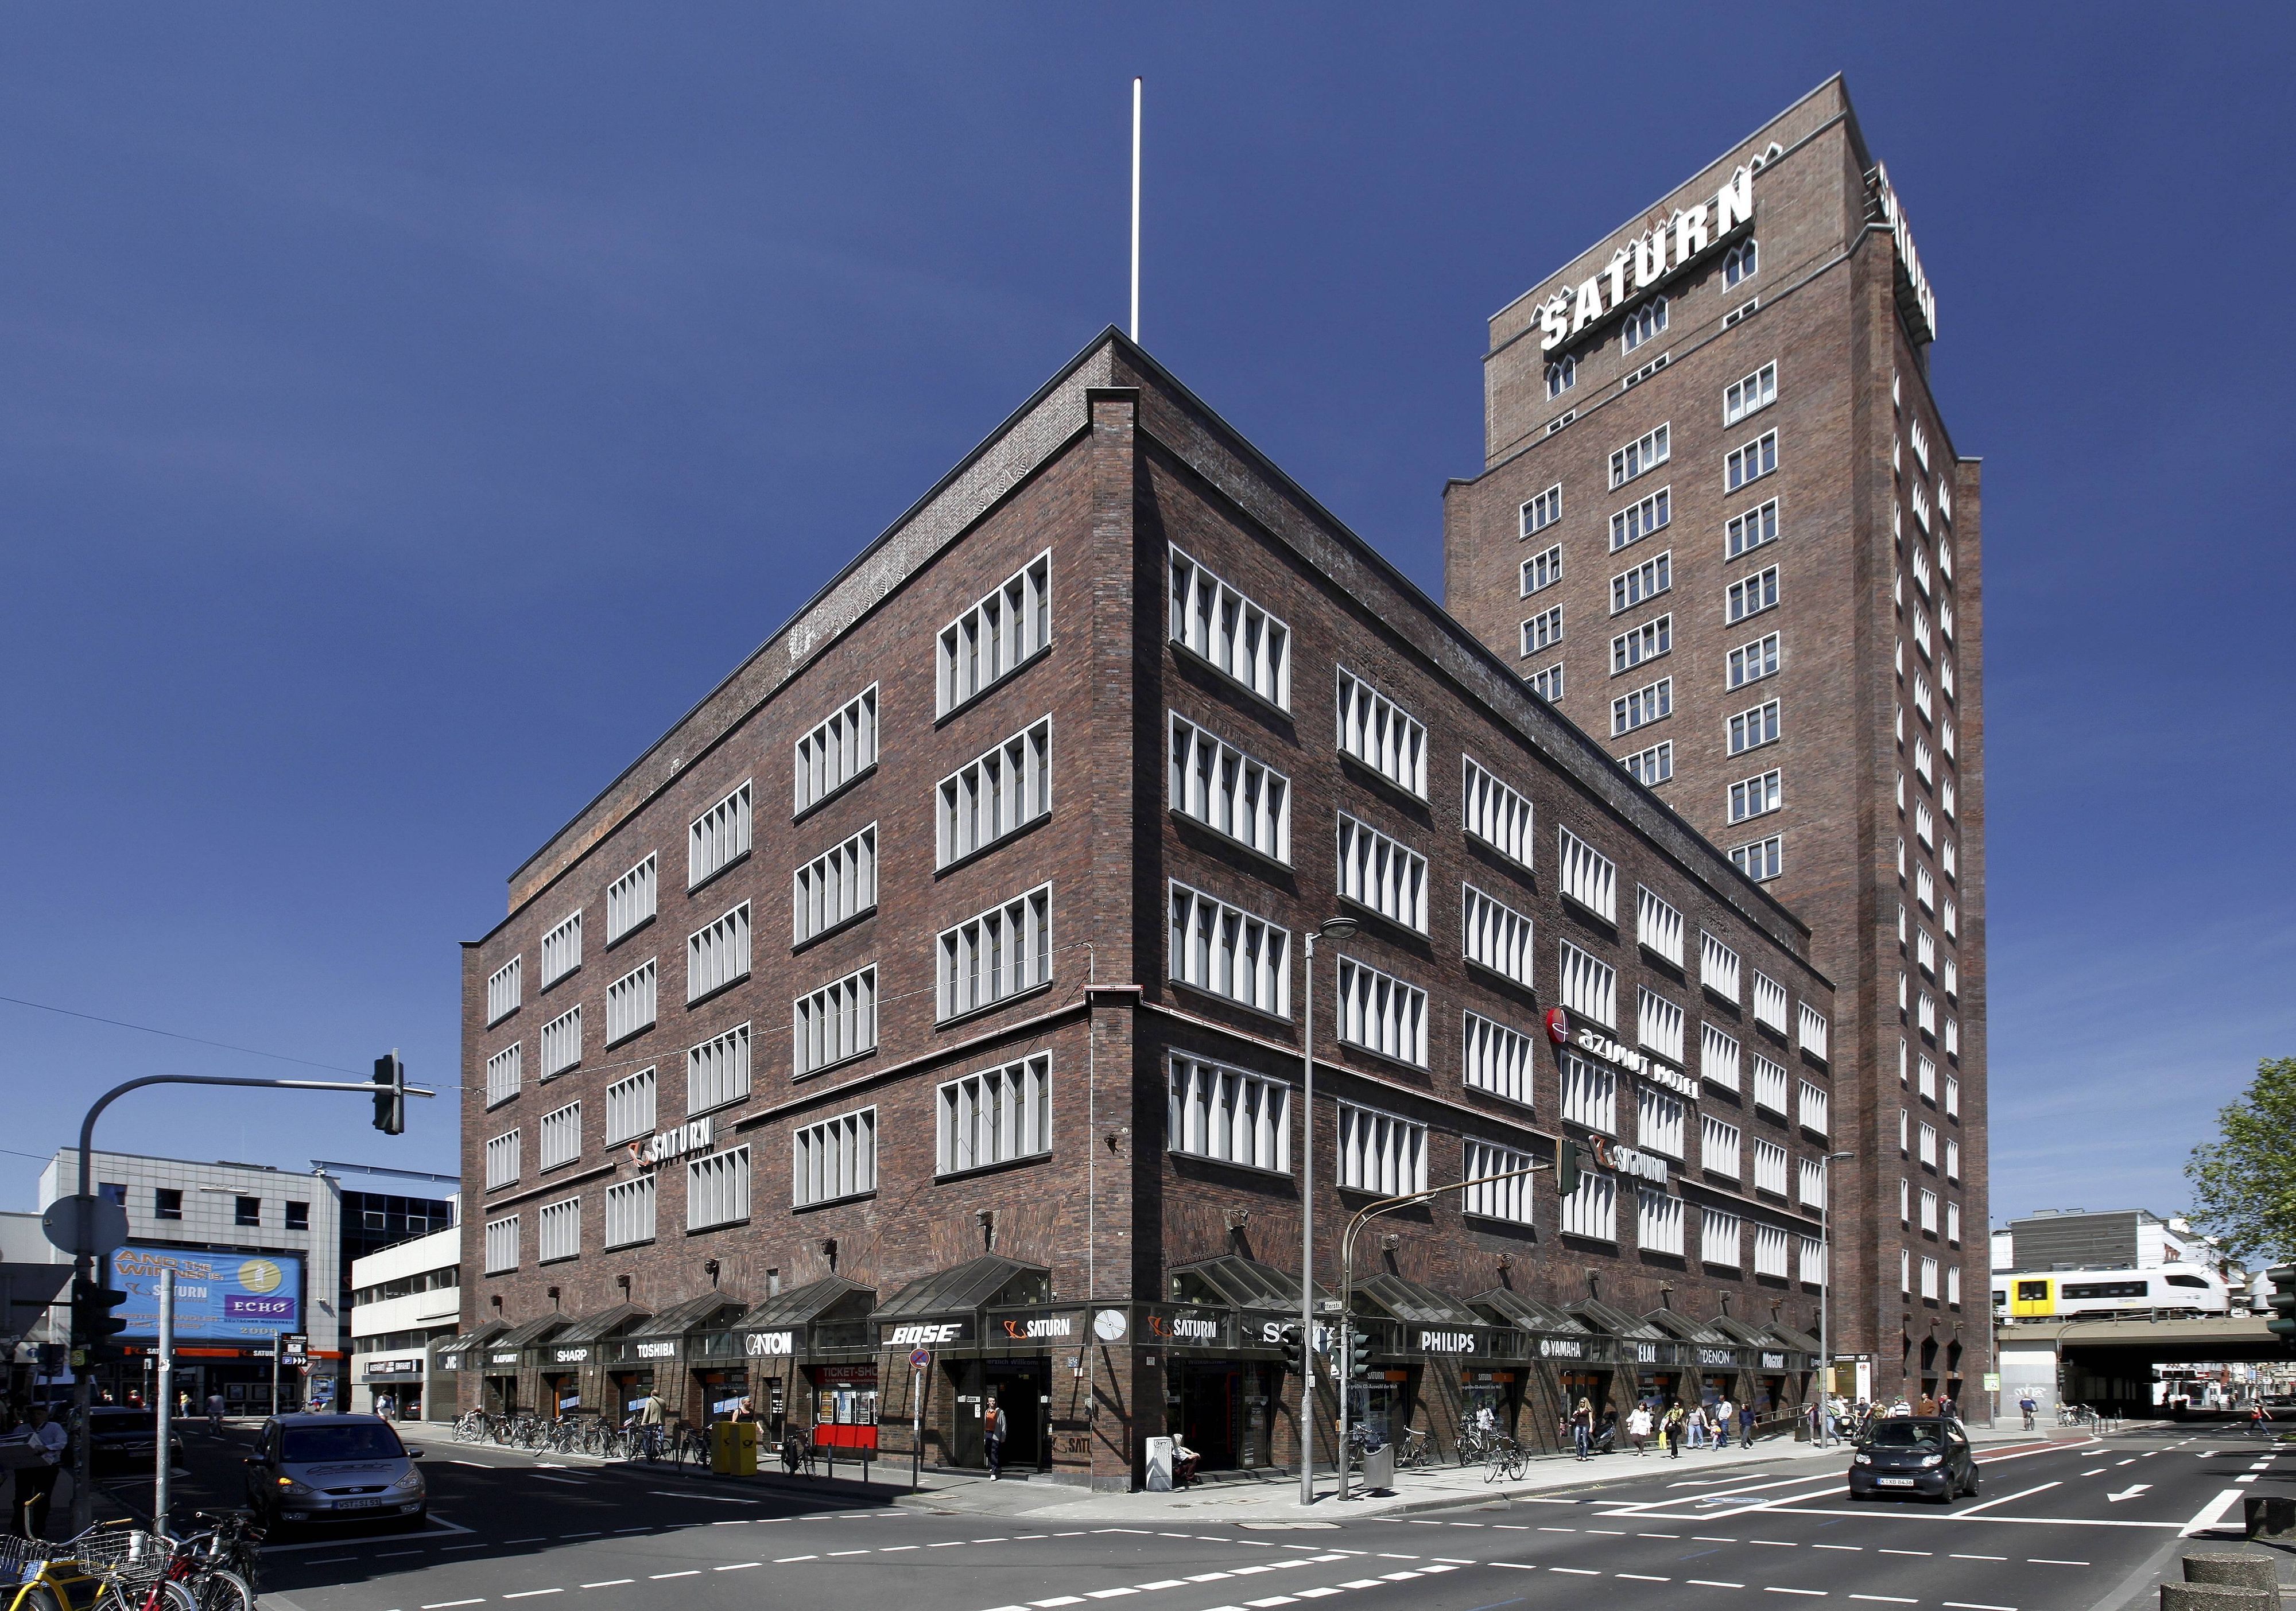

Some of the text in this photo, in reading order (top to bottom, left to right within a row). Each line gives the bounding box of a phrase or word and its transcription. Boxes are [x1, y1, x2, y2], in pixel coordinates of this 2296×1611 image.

[1540, 168, 1754, 351] SATURN
[1654, 1063, 1699, 1099] HOTEL
[651, 1116, 712, 1162] SATURN
[1612, 1144, 1667, 1184] SATURN
[115, 1250, 212, 1272] AND THE
[208, 1272, 224, 1281] IS:
[153, 1284, 207, 1298] STURN
[234, 1301, 286, 1313] ECHO
[882, 1323, 963, 1345] BOSE
[1026, 1318, 1070, 1338] SATURN
[1173, 1318, 1216, 1338] SATURN
[1263, 1322, 1336, 1343] SY
[637, 1342, 675, 1358] TOSHIBA
[746, 1331, 792, 1355] CANTON
[1422, 1331, 1475, 1353] PHILIPS
[1550, 1340, 1581, 1358] YAMAHA
[445, 1356, 456, 1369] JVC
[557, 1349, 587, 1362] SHARP
[1638, 1344, 1656, 1363] ELAC
[1702, 1349, 1730, 1364] DENON
[1367, 1372, 1384, 1380] SATURN
